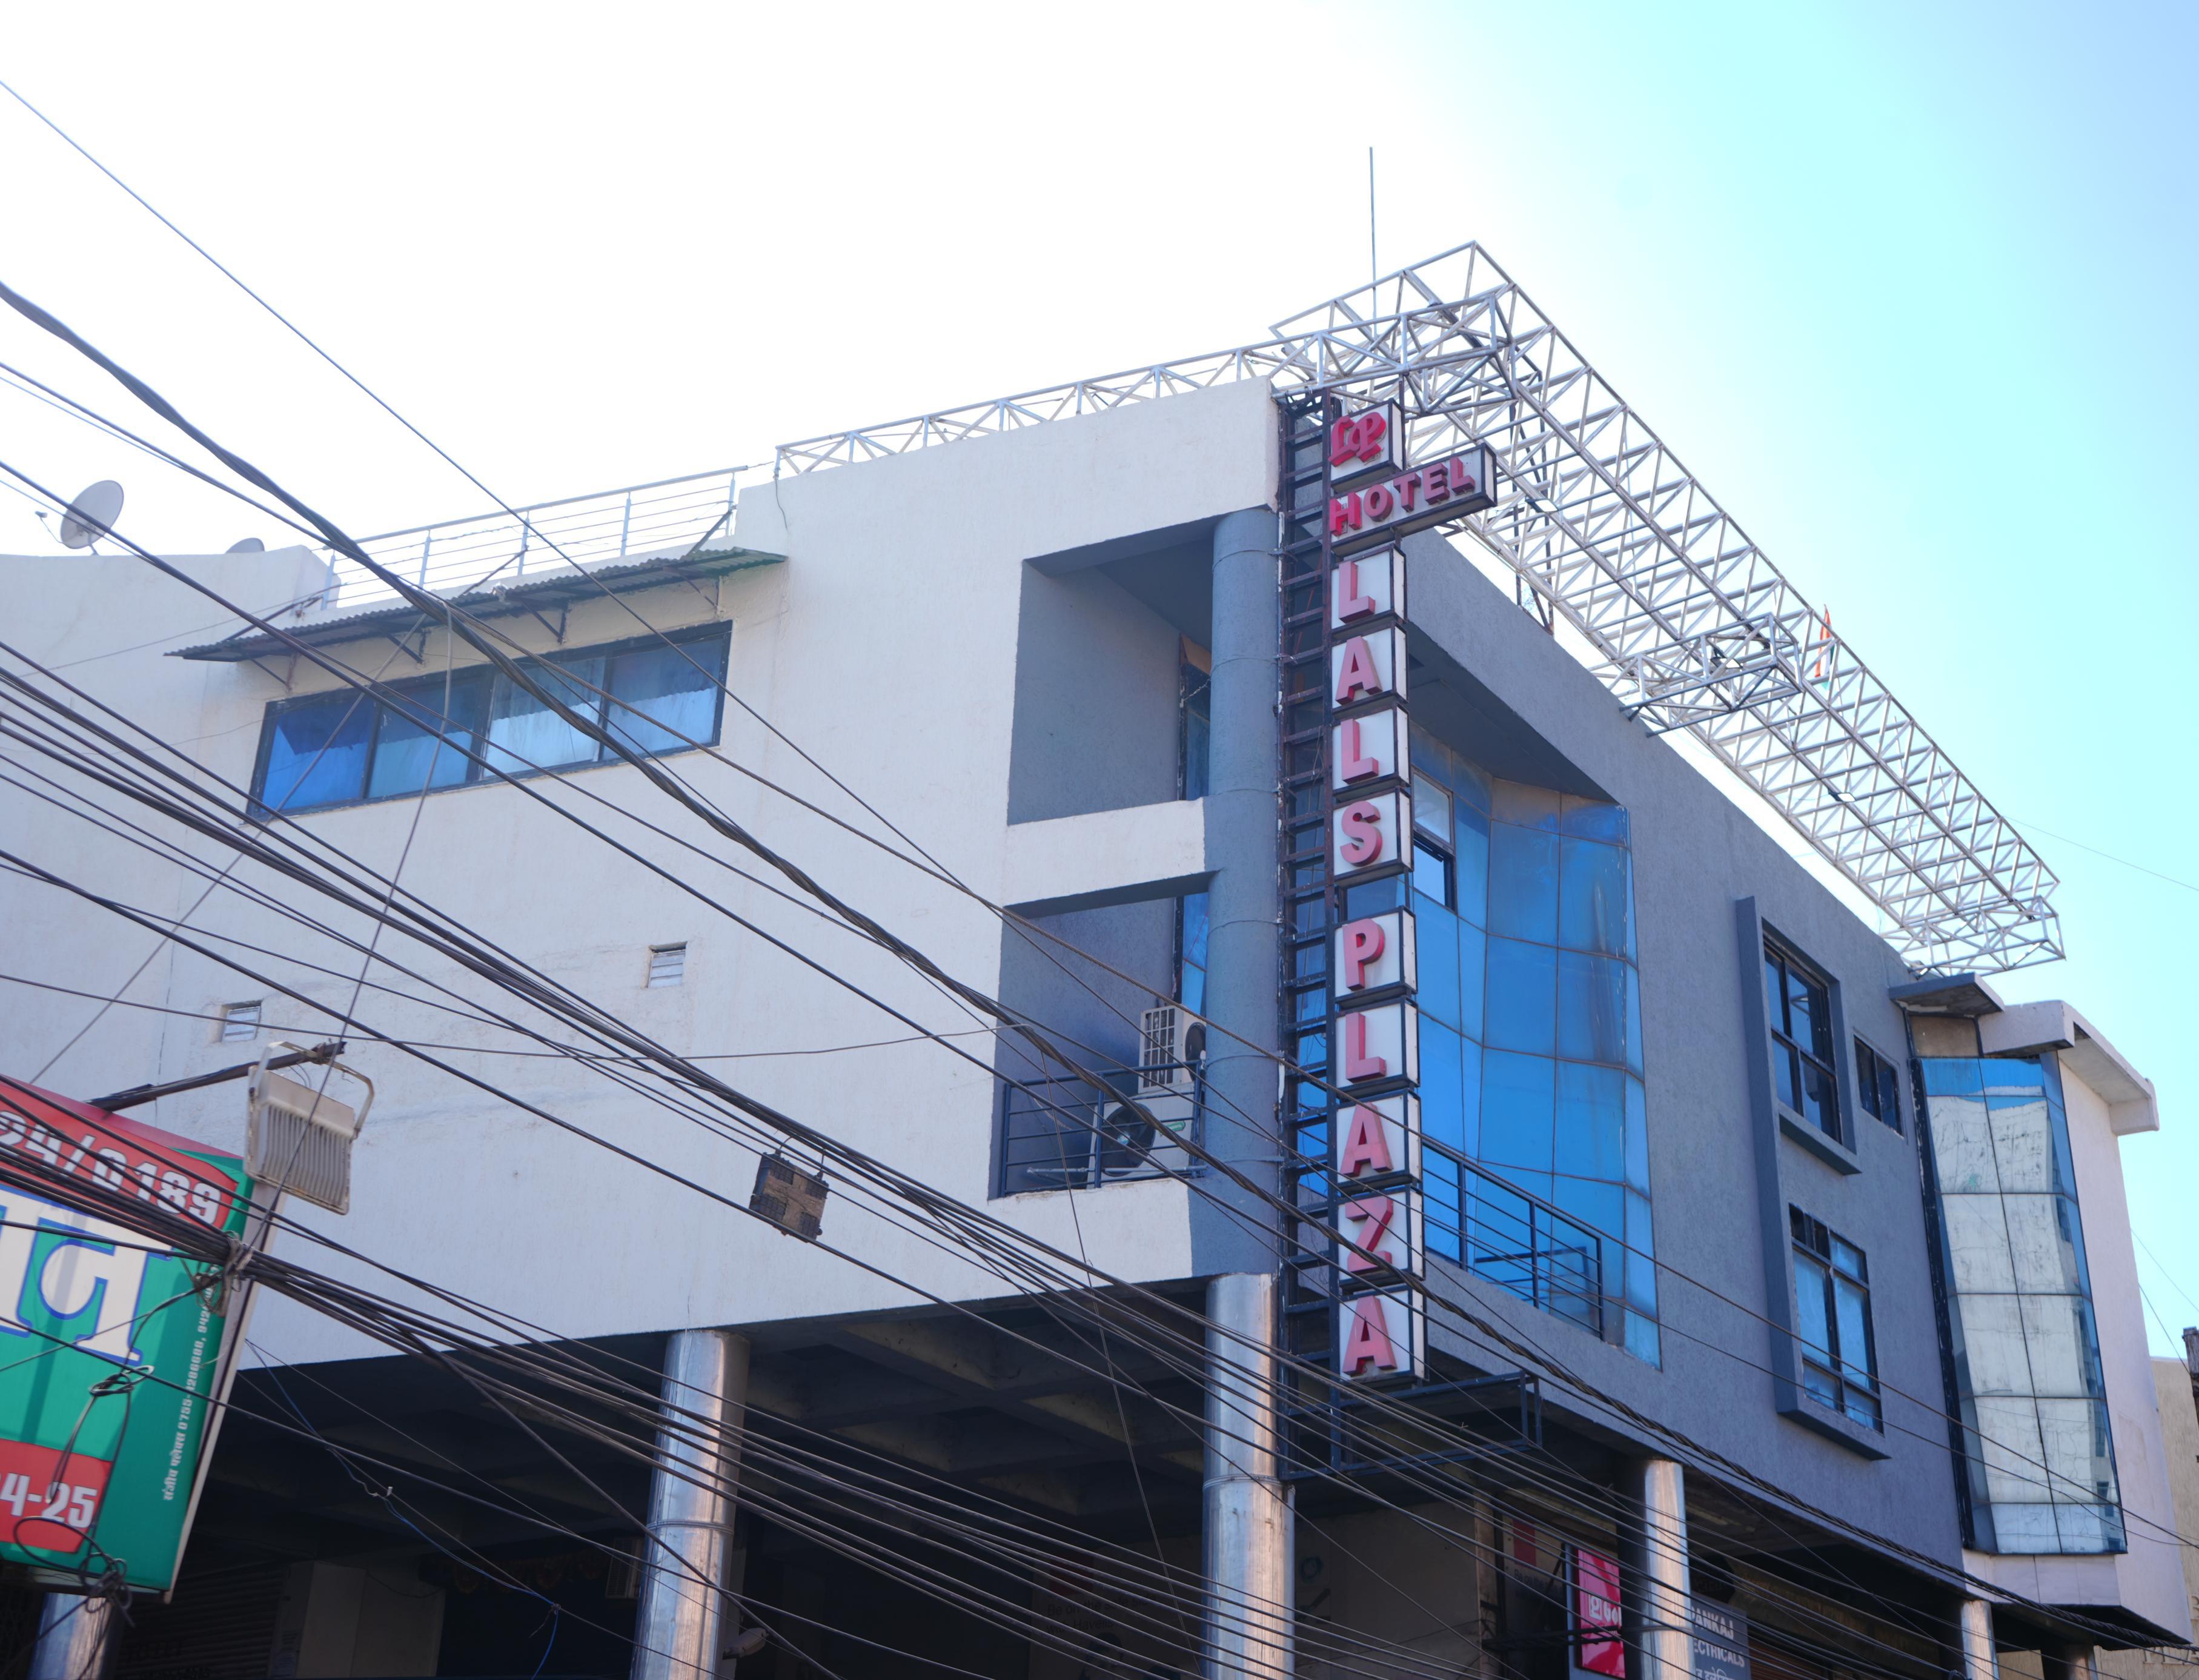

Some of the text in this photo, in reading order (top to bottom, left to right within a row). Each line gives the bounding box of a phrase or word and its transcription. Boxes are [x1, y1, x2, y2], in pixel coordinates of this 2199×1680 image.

[1329, 456, 1475, 536] HOTEL
[1335, 560, 1384, 867] LALS
[1339, 917, 1398, 1376] PLAZA
[0, 1472, 98, 1528] 4-25
